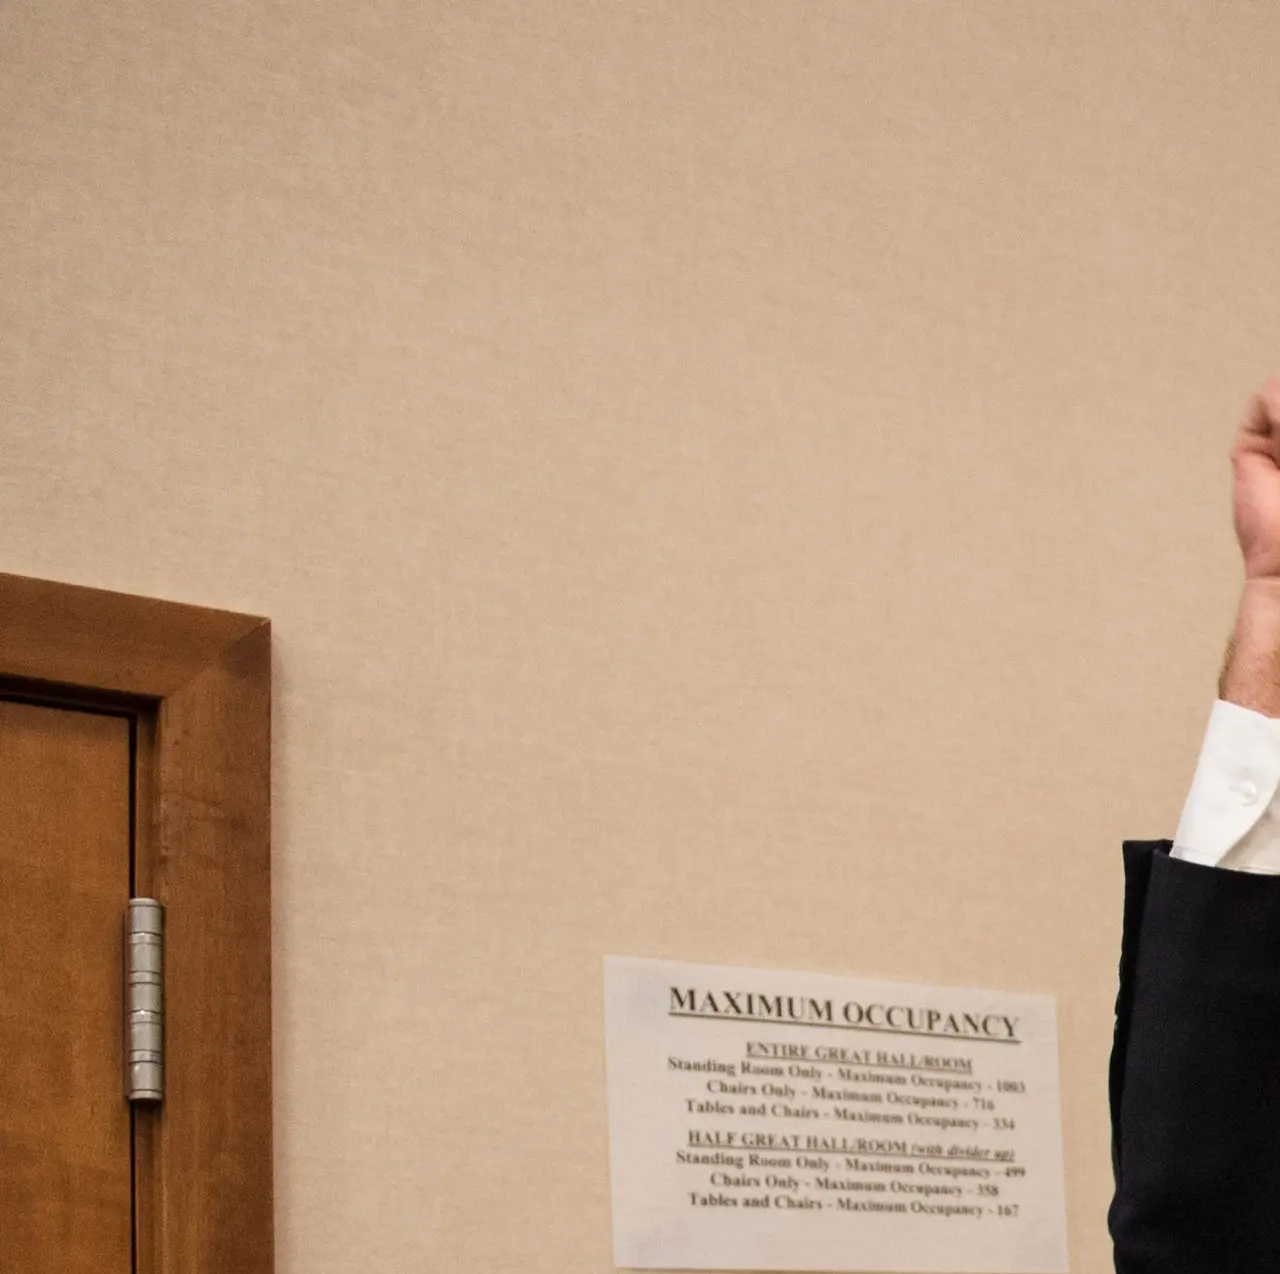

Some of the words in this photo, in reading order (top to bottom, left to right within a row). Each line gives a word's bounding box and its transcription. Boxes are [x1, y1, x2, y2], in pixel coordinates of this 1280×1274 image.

[669, 986, 833, 1022] MAXIMUM
[842, 999, 1021, 1038] OCCUPANCY
[746, 1041, 810, 1058] ENTIRE
[814, 1046, 872, 1062] GREAT
[876, 1051, 973, 1071] HALL/ROOM
[668, 1057, 736, 1077] Standing
[741, 1061, 784, 1077] Room
[788, 1064, 822, 1080] Only
[837, 1067, 907, 1085] Maximum
[911, 1074, 982, 1092] Occupancy
[706, 1079, 757, 1095] Chairs
[761, 1082, 796, 1099] Only
[812, 1085, 883, 1102] Maximum
[886, 1091, 958, 1109] Occupancy
[685, 1098, 735, 1114] Tables
[740, 1102, 766, 1116] and
[771, 1103, 820, 1118] Chairs
[833, 1106, 904, 1125] Maximum
[907, 1113, 979, 1130] Occupancy
[688, 1129, 737, 1147] HALF
[741, 1132, 800, 1150] GREAT
[806, 1135, 908, 1153] HALL/ROOM
[947, 1145, 991, 1160] divider
[676, 1150, 744, 1169] Standing
[749, 1153, 792, 1168] Room
[796, 1156, 829, 1171] Only
[845, 1157, 914, 1174] Maximum
[918, 1162, 990, 1179] Occupancy
[710, 1172, 761, 1188] Chairs
[765, 1174, 799, 1191] Only
[815, 1176, 886, 1193] Maximum
[890, 1181, 962, 1198] Occupancy
[688, 1192, 738, 1207] Tables
[742, 1195, 769, 1208] and
[774, 1195, 822, 1210] Chairs
[837, 1197, 907, 1214] Maximum
[910, 1202, 983, 1218] Occupancy
